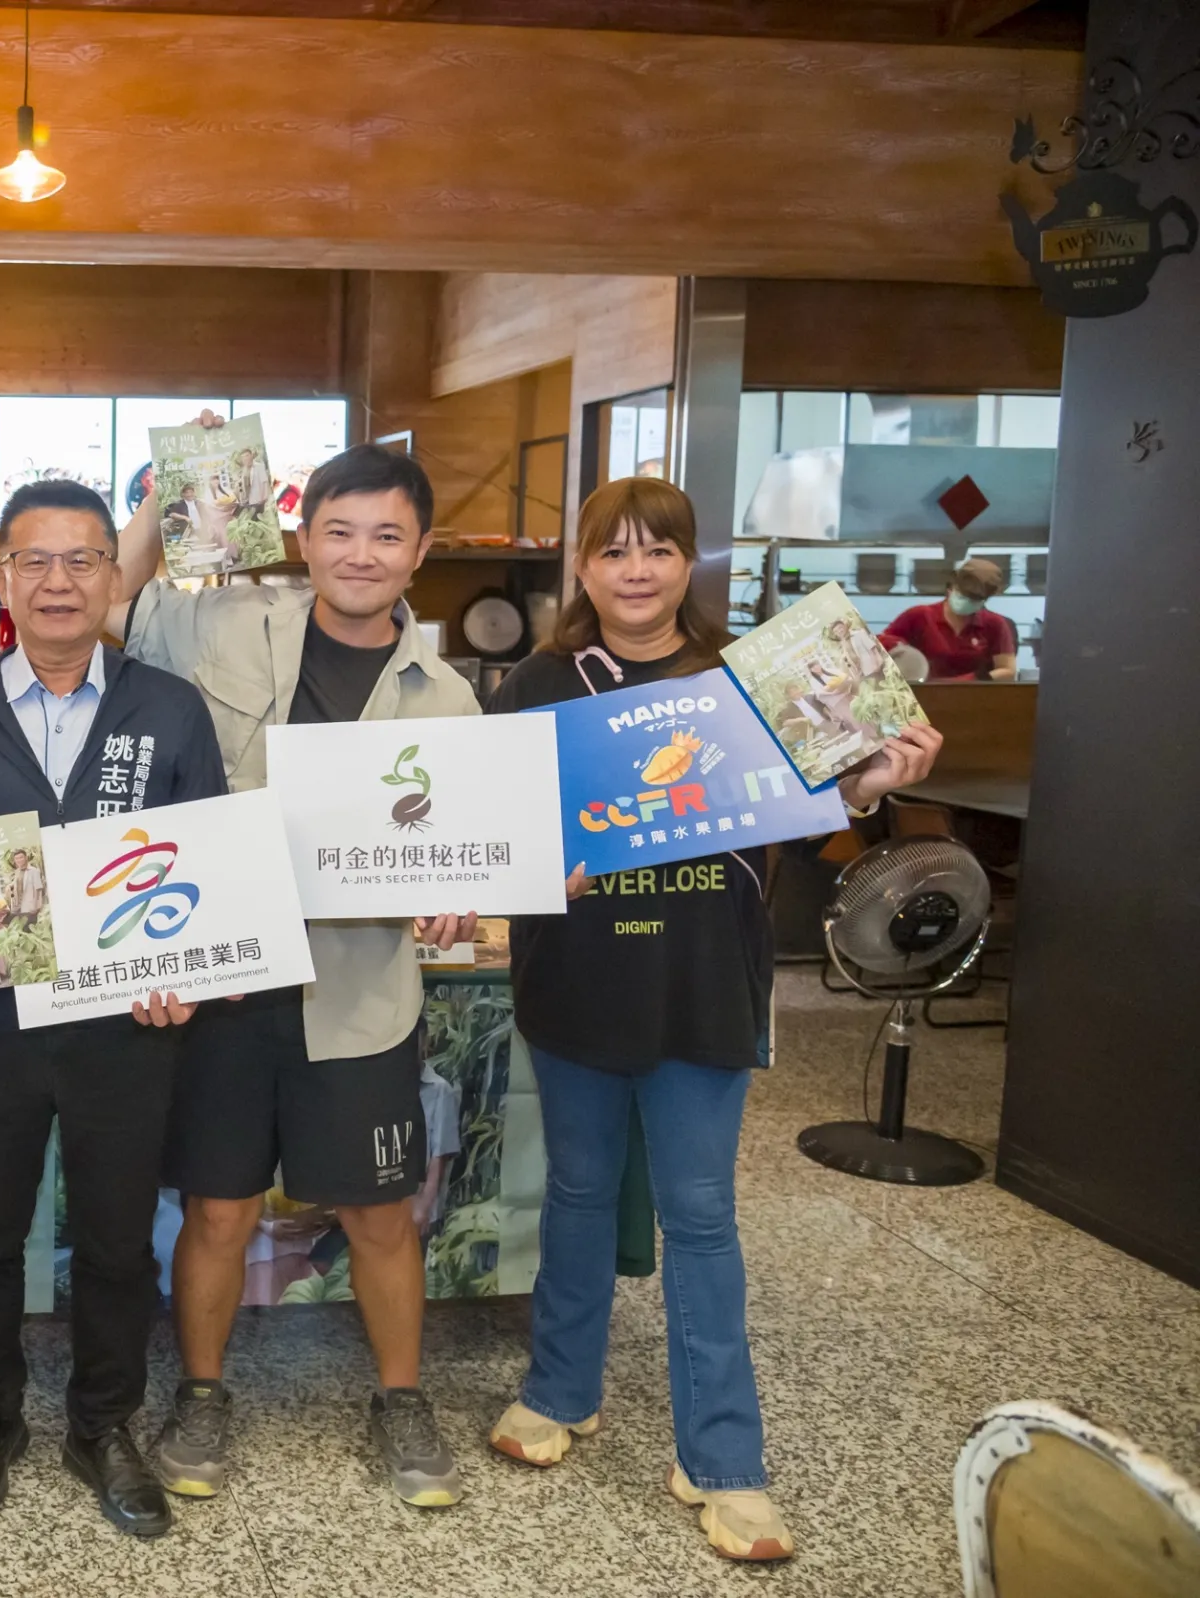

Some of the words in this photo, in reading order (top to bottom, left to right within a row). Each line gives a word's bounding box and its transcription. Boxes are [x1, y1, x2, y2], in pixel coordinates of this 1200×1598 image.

[607, 696, 717, 734] MANGO
[317, 841, 511, 870] 阿金的便秘花園
[341, 875, 381, 884] A-JIN'S
[385, 873, 433, 883] SECRET
[436, 872, 490, 882] GARDEN
[663, 864, 726, 892] LOSE
[52, 938, 262, 994] 高雄市政府農業局
[51, 995, 98, 1009] Agriculture
[100, 990, 132, 1001] Bureau
[134, 987, 143, 996] of
[146, 979, 192, 993] Kaohsiung
[194, 976, 212, 987] City
[214, 967, 269, 982] Government
